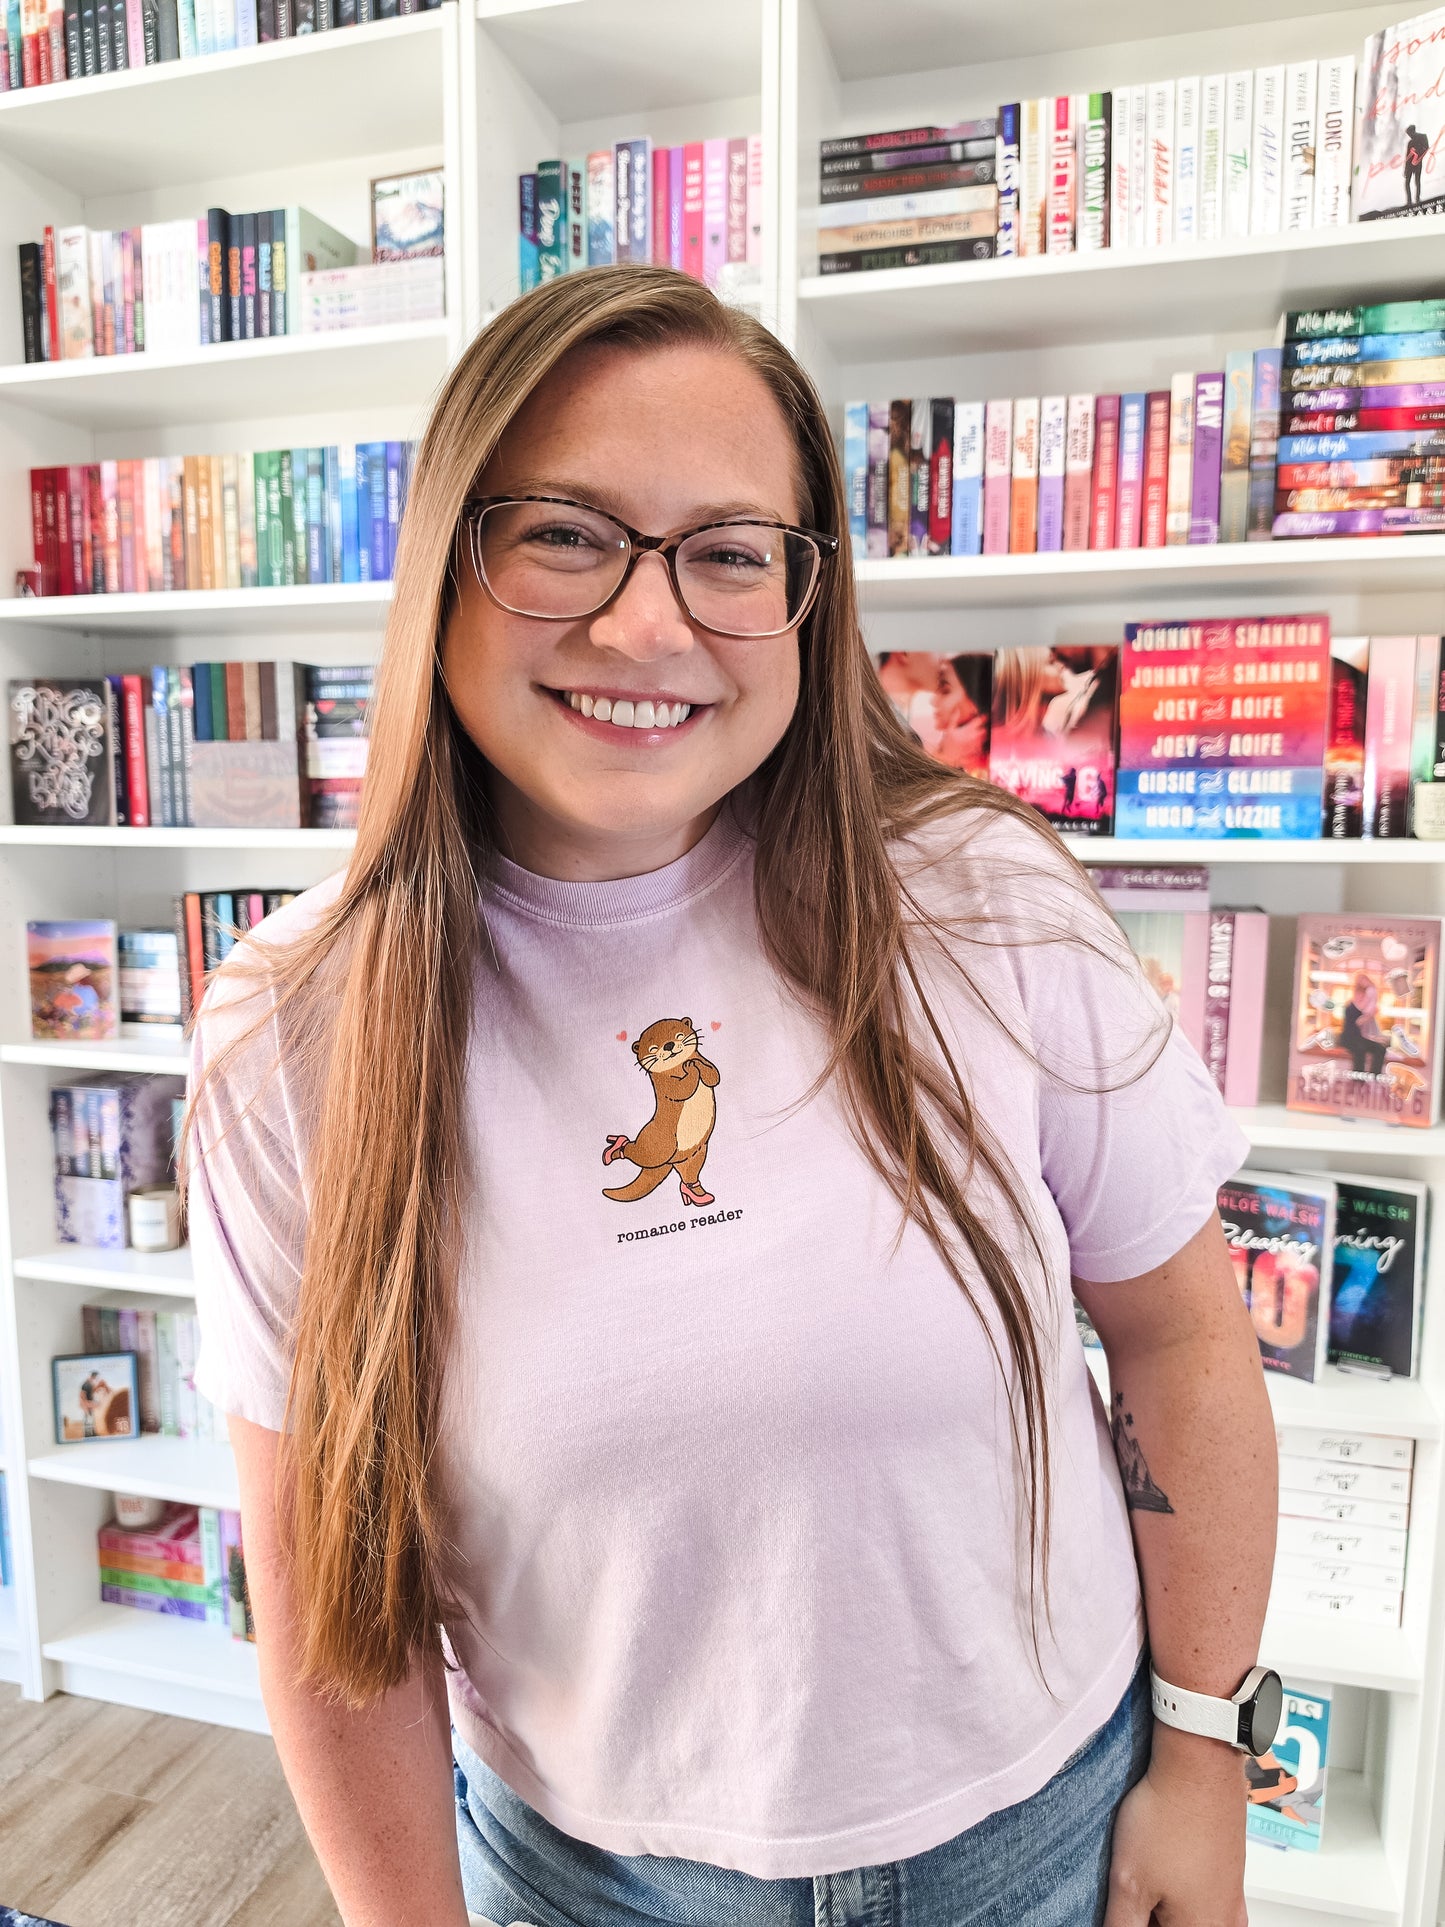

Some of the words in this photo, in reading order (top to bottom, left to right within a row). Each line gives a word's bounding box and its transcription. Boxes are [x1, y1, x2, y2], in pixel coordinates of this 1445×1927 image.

[1324, 110, 1343, 152] LONG
[1196, 381, 1222, 428] PLAY
[1131, 626, 1202, 653] JOHNNY
[1235, 623, 1322, 647] SHANNON
[1130, 664, 1200, 689] JOHNNY
[1233, 662, 1320, 685] SHANNON
[1153, 698, 1197, 721] JOEY
[1231, 696, 1283, 719] AOIFE
[1150, 734, 1197, 758] JOEY
[1228, 733, 1283, 757] AOIFE
[1227, 770, 1292, 794] CLAIRE
[1224, 805, 1282, 829] LIZZIE
[1209, 922, 1233, 982] SAVING
[1265, 1203, 1321, 1227] WALSH
[1352, 1198, 1411, 1221] WALSH
[617, 1220, 686, 1243] romance
[690, 1208, 743, 1229] reader
